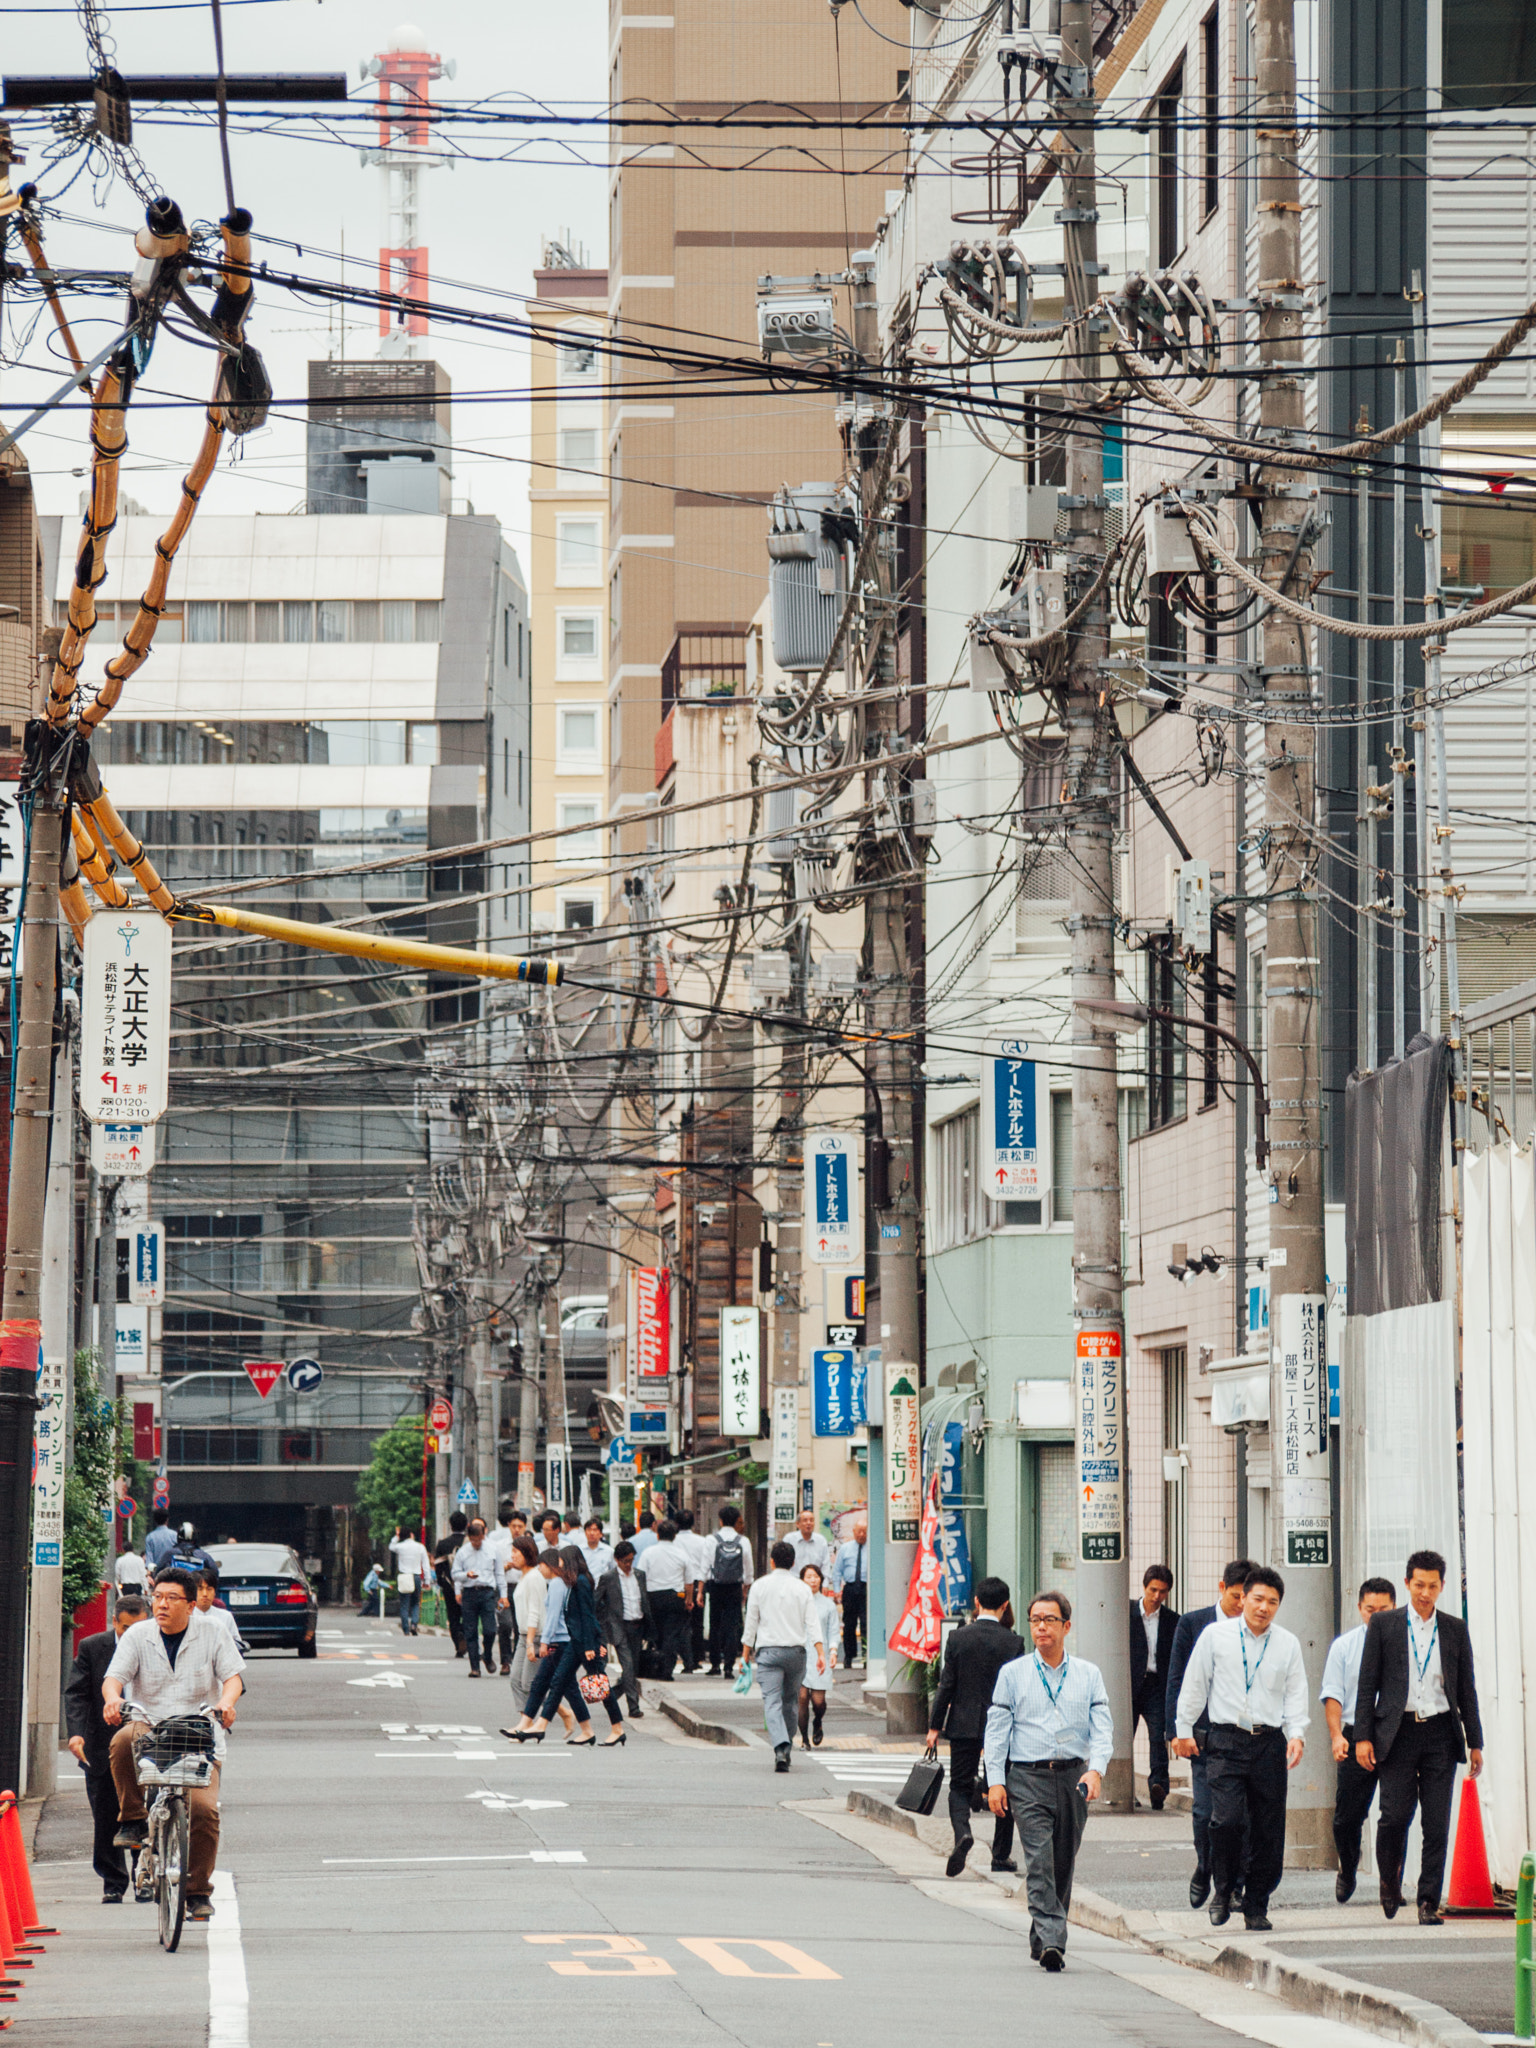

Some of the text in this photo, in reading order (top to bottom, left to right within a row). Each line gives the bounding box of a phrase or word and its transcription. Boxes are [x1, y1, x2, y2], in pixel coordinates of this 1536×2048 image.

[103, 962, 118, 1067] 浜松町サテライト教室
[121, 963, 150, 1067] 大正大学
[98, 1108, 150, 1117] 721-310
[1008, 1061, 1023, 1146] アートホテルズ
[108, 1133, 140, 1142] 浜松町
[998, 1151, 1034, 1161] 浜松町
[825, 1154, 839, 1222] アートホテルズ
[996, 1186, 1038, 1194] 3432-2726
[819, 1224, 847, 1233] 浜松町
[639, 1270, 662, 1376] makita
[1081, 1337, 1117, 1346] 口腔がん
[252, 1369, 277, 1379] 止まれ
[1301, 1302, 1316, 1436] 株式会社プレニーズ
[39, 1393, 51, 1466] 事務所
[1082, 1361, 1095, 1457] 歯科・口腔外科
[1102, 1360, 1117, 1456] 芝クリニック
[1285, 1354, 1299, 1476] 部屋ニーズ浜松町店
[51, 1393, 64, 1497] マンション
[907, 1398, 917, 1482] ビッグな安さ!
[891, 1452, 906, 1488] モリ
[1088, 1538, 1115, 1547] 浜松町
[1089, 1549, 1115, 1558] 1-23
[1295, 1538, 1325, 1548] 浜松町
[1296, 1551, 1324, 1561] 1-24
[521, 1934, 845, 1980] 30
